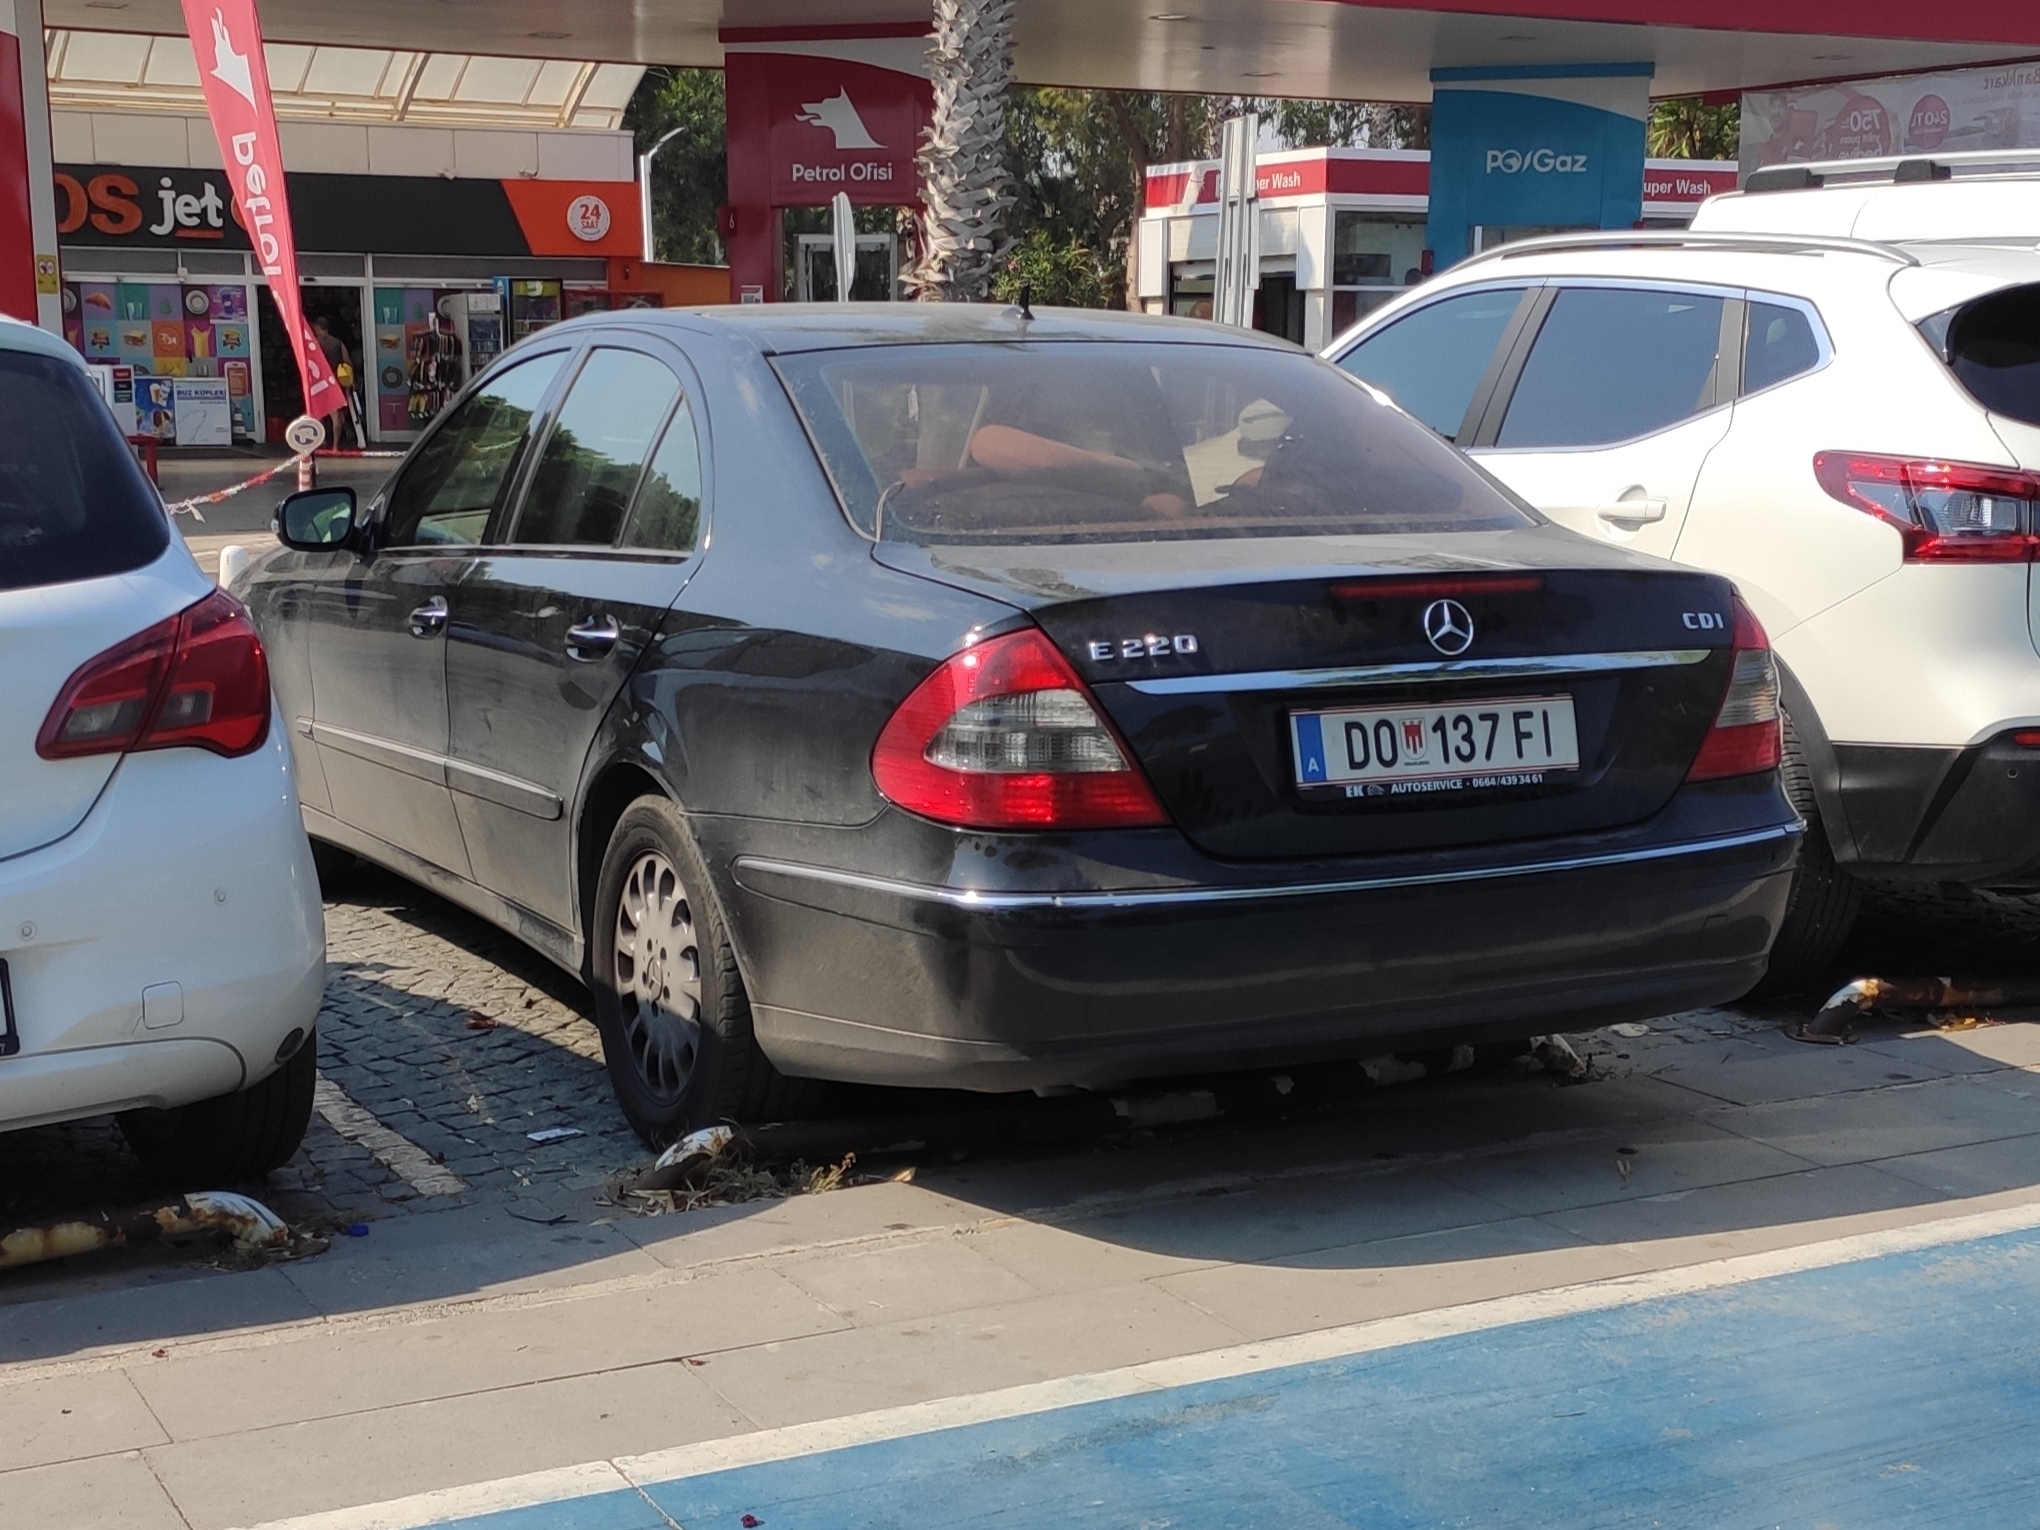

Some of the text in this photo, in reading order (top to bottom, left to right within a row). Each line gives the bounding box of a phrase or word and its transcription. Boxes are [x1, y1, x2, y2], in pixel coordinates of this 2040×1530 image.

[792, 162, 893, 182] Petrol Ofisi
[1272, 170, 1301, 190] Wash
[1643, 178, 1711, 197] uper Wash
[149, 177, 224, 236] jet
[579, 203, 601, 220] 24
[581, 220, 599, 230] SAAT
[1682, 612, 1724, 629] CDI
[1089, 634, 1198, 660] E 220
[1307, 709, 1552, 773] A DO 137 FI
[1345, 785, 1364, 798] EK
[1391, 779, 1463, 794] AUTOSERVICE
